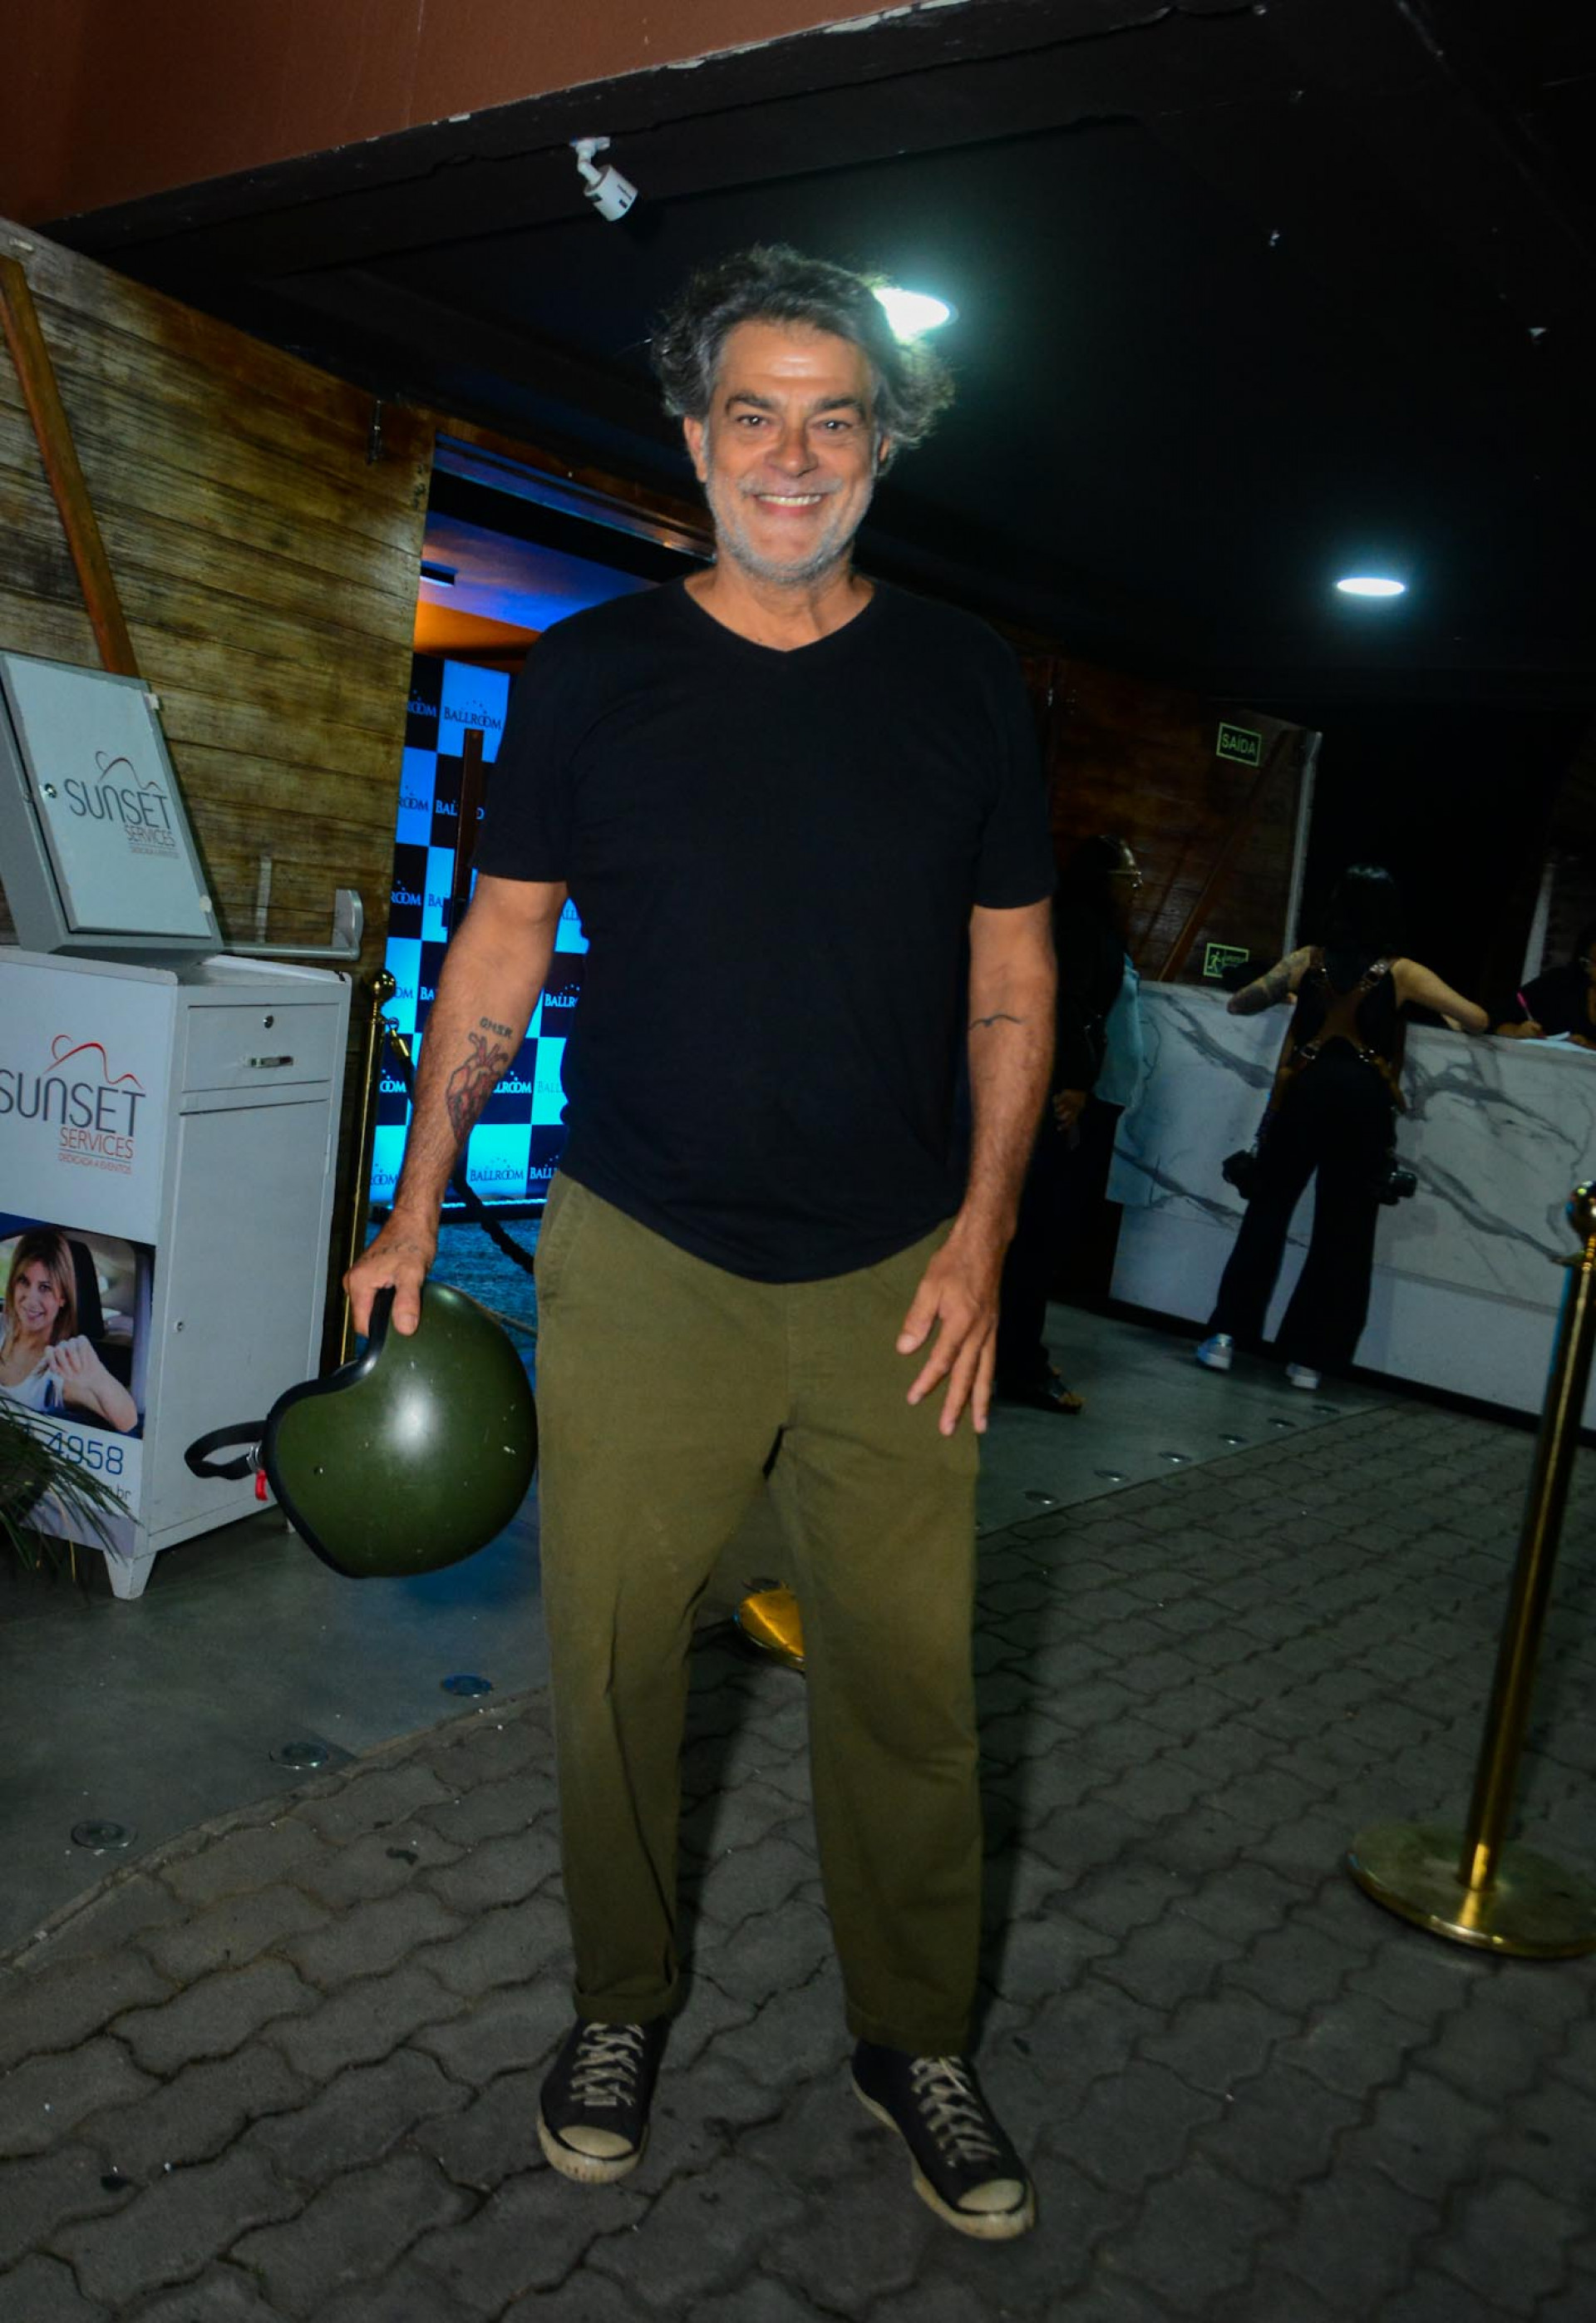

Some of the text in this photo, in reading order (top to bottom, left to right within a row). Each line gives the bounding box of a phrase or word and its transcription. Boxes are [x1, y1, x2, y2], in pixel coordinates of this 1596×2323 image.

[444, 707, 501, 730] BALLROOM
[64, 778, 171, 830] SUNSET
[0, 1069, 146, 1137] SUNSET
[59, 1127, 134, 1159] SERVICES
[470, 1169, 524, 1181] BALLROOM
